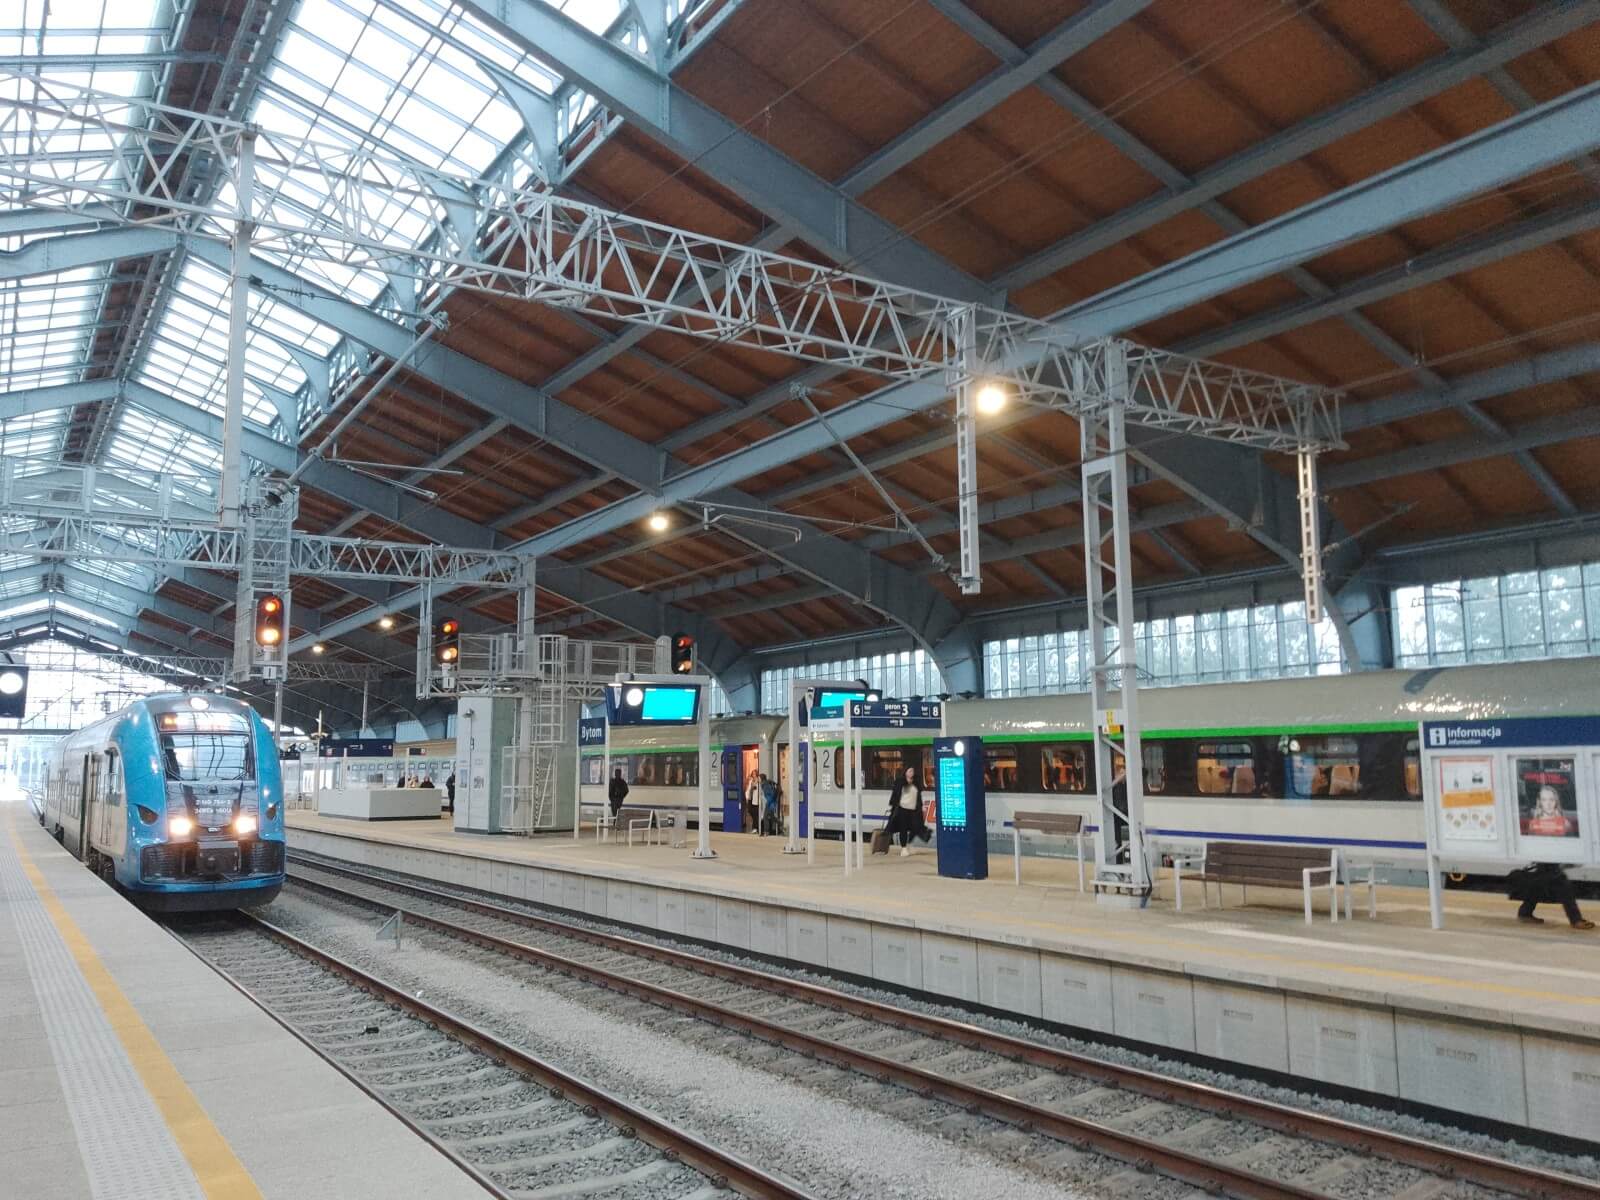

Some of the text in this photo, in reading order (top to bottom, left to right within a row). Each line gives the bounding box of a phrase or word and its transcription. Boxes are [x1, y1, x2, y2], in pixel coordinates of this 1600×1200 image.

[854, 704, 860, 715] 6
[902, 704, 909, 716] 3
[932, 706, 938, 717] 8
[581, 726, 602, 741] Bytom
[711, 752, 718, 768] 2
[822, 749, 830, 768] 2
